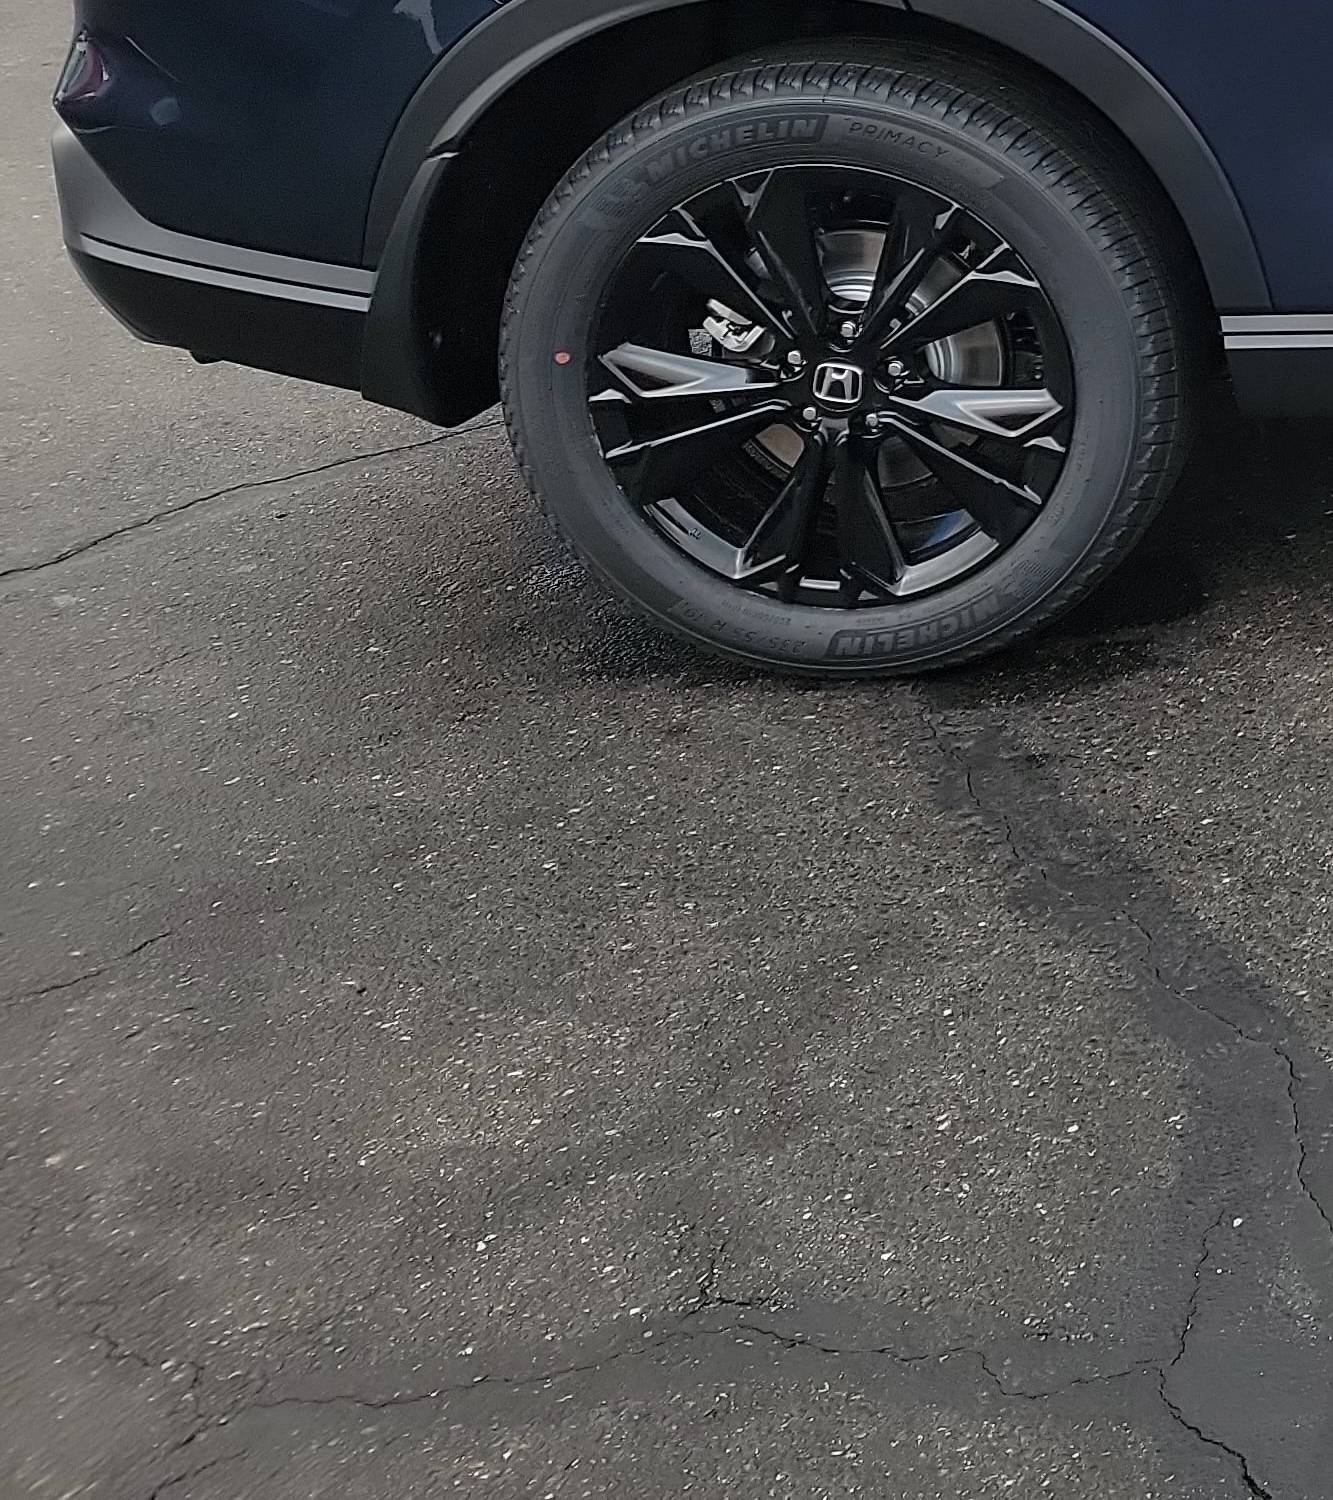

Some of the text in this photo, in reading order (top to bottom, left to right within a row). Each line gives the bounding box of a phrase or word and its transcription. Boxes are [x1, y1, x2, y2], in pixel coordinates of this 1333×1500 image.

[646, 116, 951, 181] MICHELIN PRIMACY
[837, 594, 1000, 657] MICHELIN
